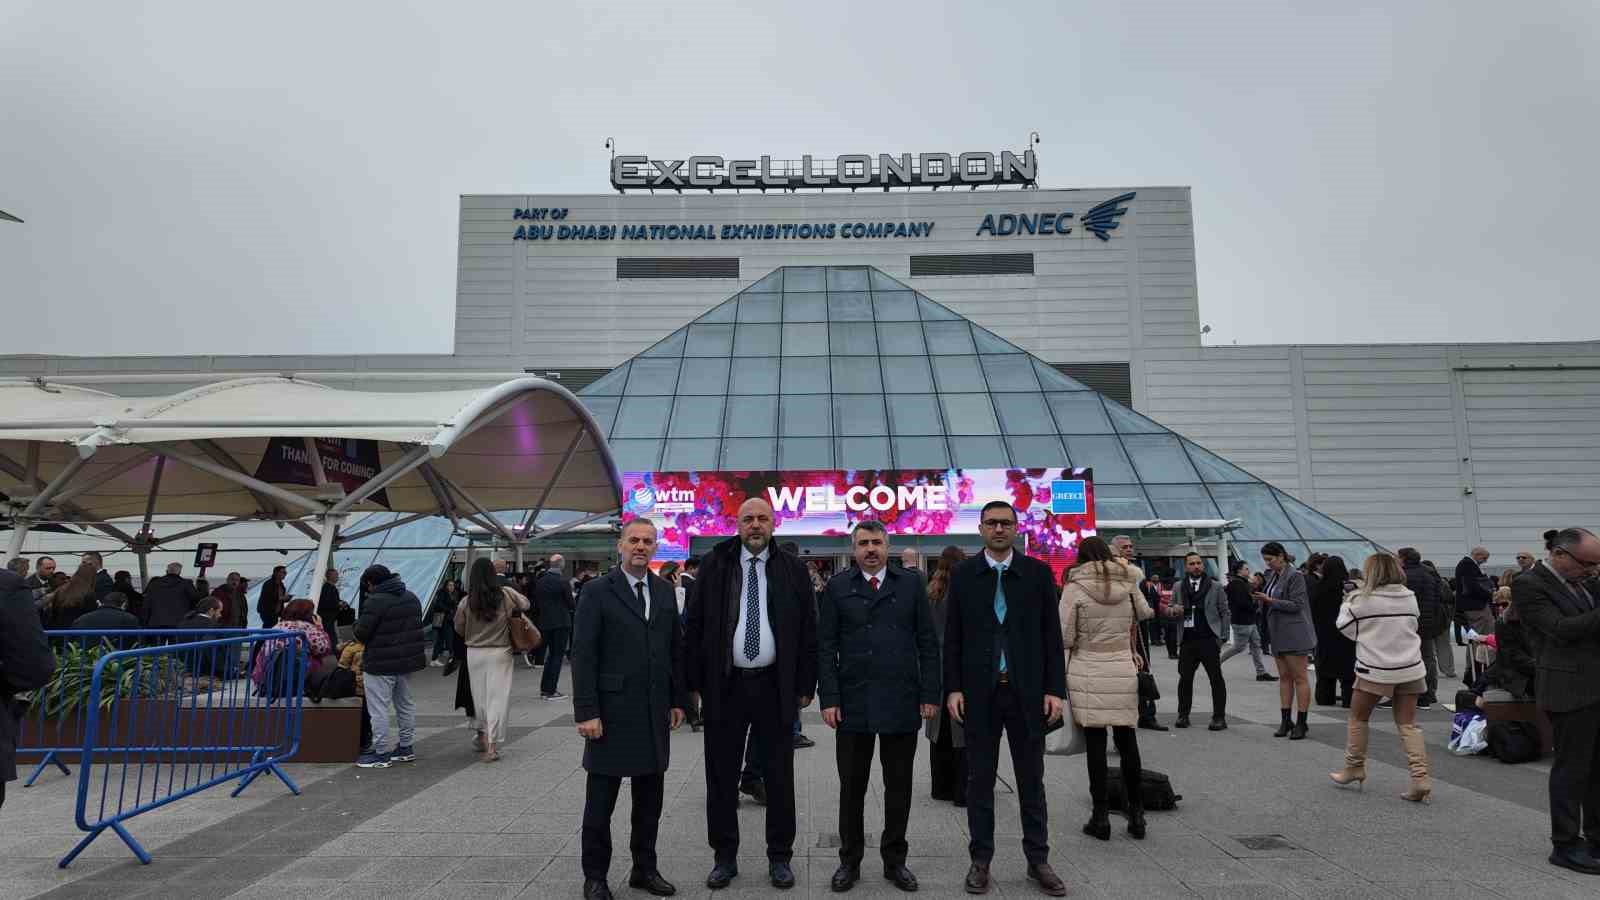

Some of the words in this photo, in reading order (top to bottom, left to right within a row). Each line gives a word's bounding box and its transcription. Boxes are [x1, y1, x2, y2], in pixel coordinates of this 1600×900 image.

[803, 150, 1035, 184] LONDON
[513, 208, 548, 220] PART
[551, 208, 568, 220] OF
[513, 225, 552, 240] ABU
[556, 225, 616, 240] DHABI
[621, 224, 716, 240] NATIONAL
[720, 224, 836, 240] EXHIBITIONS
[839, 222, 935, 239] COMPANY
[976, 213, 1074, 236] ADNEC
[281, 445, 313, 465] THAN
[322, 456, 339, 472] FOR
[655, 487, 695, 502] wtm
[768, 486, 949, 512] WELCOME
[1052, 491, 1084, 500] GREECE
